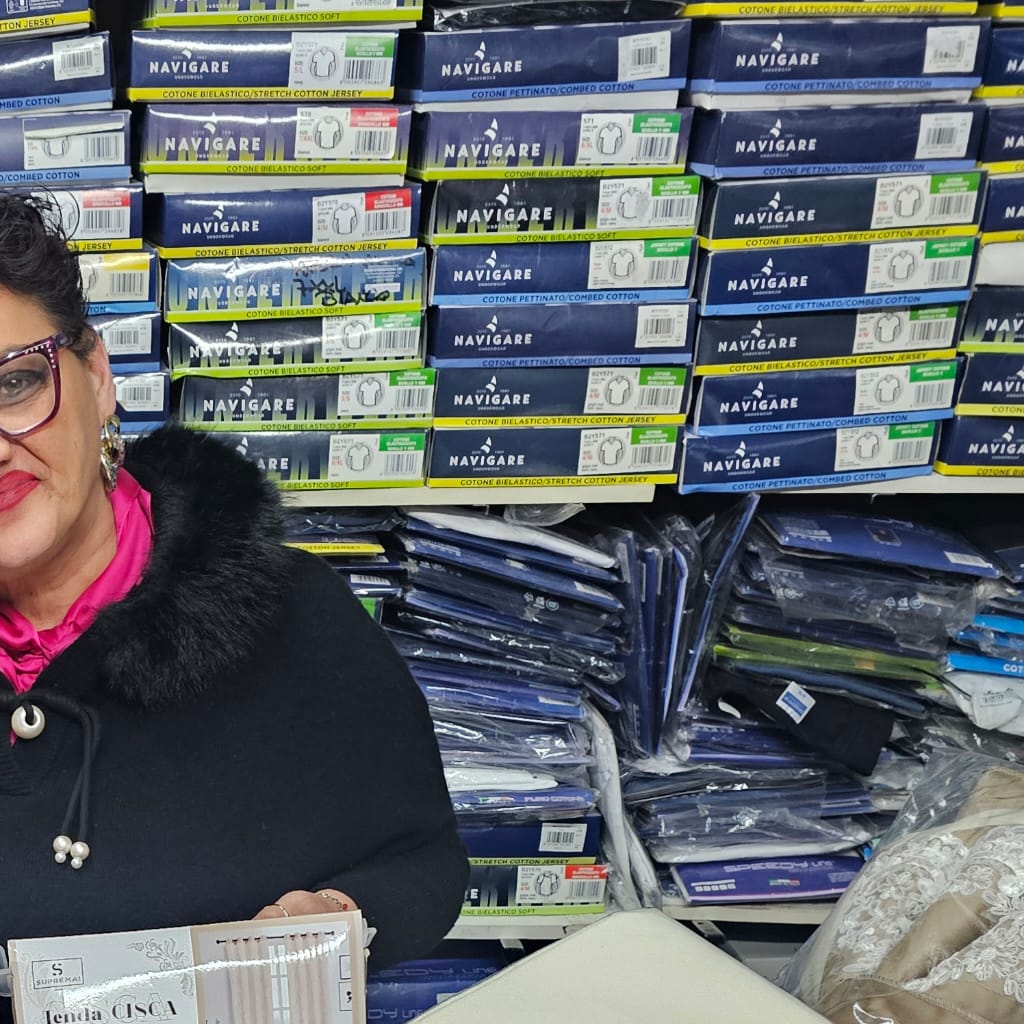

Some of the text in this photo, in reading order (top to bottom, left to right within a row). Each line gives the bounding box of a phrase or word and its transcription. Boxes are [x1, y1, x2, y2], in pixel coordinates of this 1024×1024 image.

[24, 18, 55, 28] JERSEY
[274, 14, 318, 22] BIELASTICO
[736, 53, 819, 67] NAVIGARE
[150, 62, 229, 73] NAVIGARE
[442, 60, 522, 76] NAVIGARE
[472, 83, 634, 98] COTONE PETTINATO/COMBED COTTON
[765, 82, 801, 91] COTONE
[896, 80, 932, 88] COTTON
[24, 97, 60, 107] COTTON
[165, 138, 260, 151] NAVIGARE
[444, 143, 541, 158] NAVIGARE
[736, 139, 816, 153] NAVIGARE
[46, 172, 80, 180] COTTON
[763, 167, 798, 175] COTONE
[889, 164, 925, 172] COTTON
[456, 207, 552, 224] NAVIGARE
[734, 209, 815, 225] NAVIGARE
[182, 221, 259, 234] NAVIGARE
[746, 228, 947, 247] COTONE BIELASTICO/STRETCH COTTON JERSEY
[195, 242, 387, 257] COTONE BIELASTICO/STRETCH COTTON JERSEY
[454, 268, 531, 282] NAVIGARE
[728, 276, 808, 291] NAVIGARE
[188, 284, 280, 299] NAVIGARE
[483, 293, 640, 303] COTONE PETTINATO/COMBED COTTON
[757, 295, 920, 312] COTONE PETTINATO/COMBED COTTON
[246, 310, 277, 318] COTONE
[280, 308, 322, 317] BIELASTICO
[454, 334, 532, 346] NAVIGARE
[718, 337, 797, 352] NAVIGARE
[190, 344, 281, 358] NAVIGARE
[482, 359, 516, 367] COTONE
[729, 362, 764, 372] COTONE
[860, 355, 894, 365] COTTON
[896, 353, 926, 363] JERSEY
[282, 366, 324, 374] BIELASTICO
[204, 398, 295, 411] NAVIGARE
[454, 394, 530, 406] NAVIGARE
[720, 398, 798, 413] NAVIGARE
[261, 423, 293, 431] COTONE
[502, 417, 587, 425] BIELASTICO/STRETCH
[626, 416, 656, 424] JERSEY
[749, 415, 907, 432] COTONE PETTINATO/COMBED COTTON
[968, 443, 1024, 454] NAVIGA
[450, 455, 524, 466] NAVIGARE
[703, 456, 780, 473] NAVIGARE
[496, 477, 583, 485] BIELASTICO/STRETCH
[619, 476, 648, 484] JERSEY
[732, 472, 886, 491] COTONE PETTINATO/COMBED COTTON
[112, 1001, 177, 1019] CISCA
